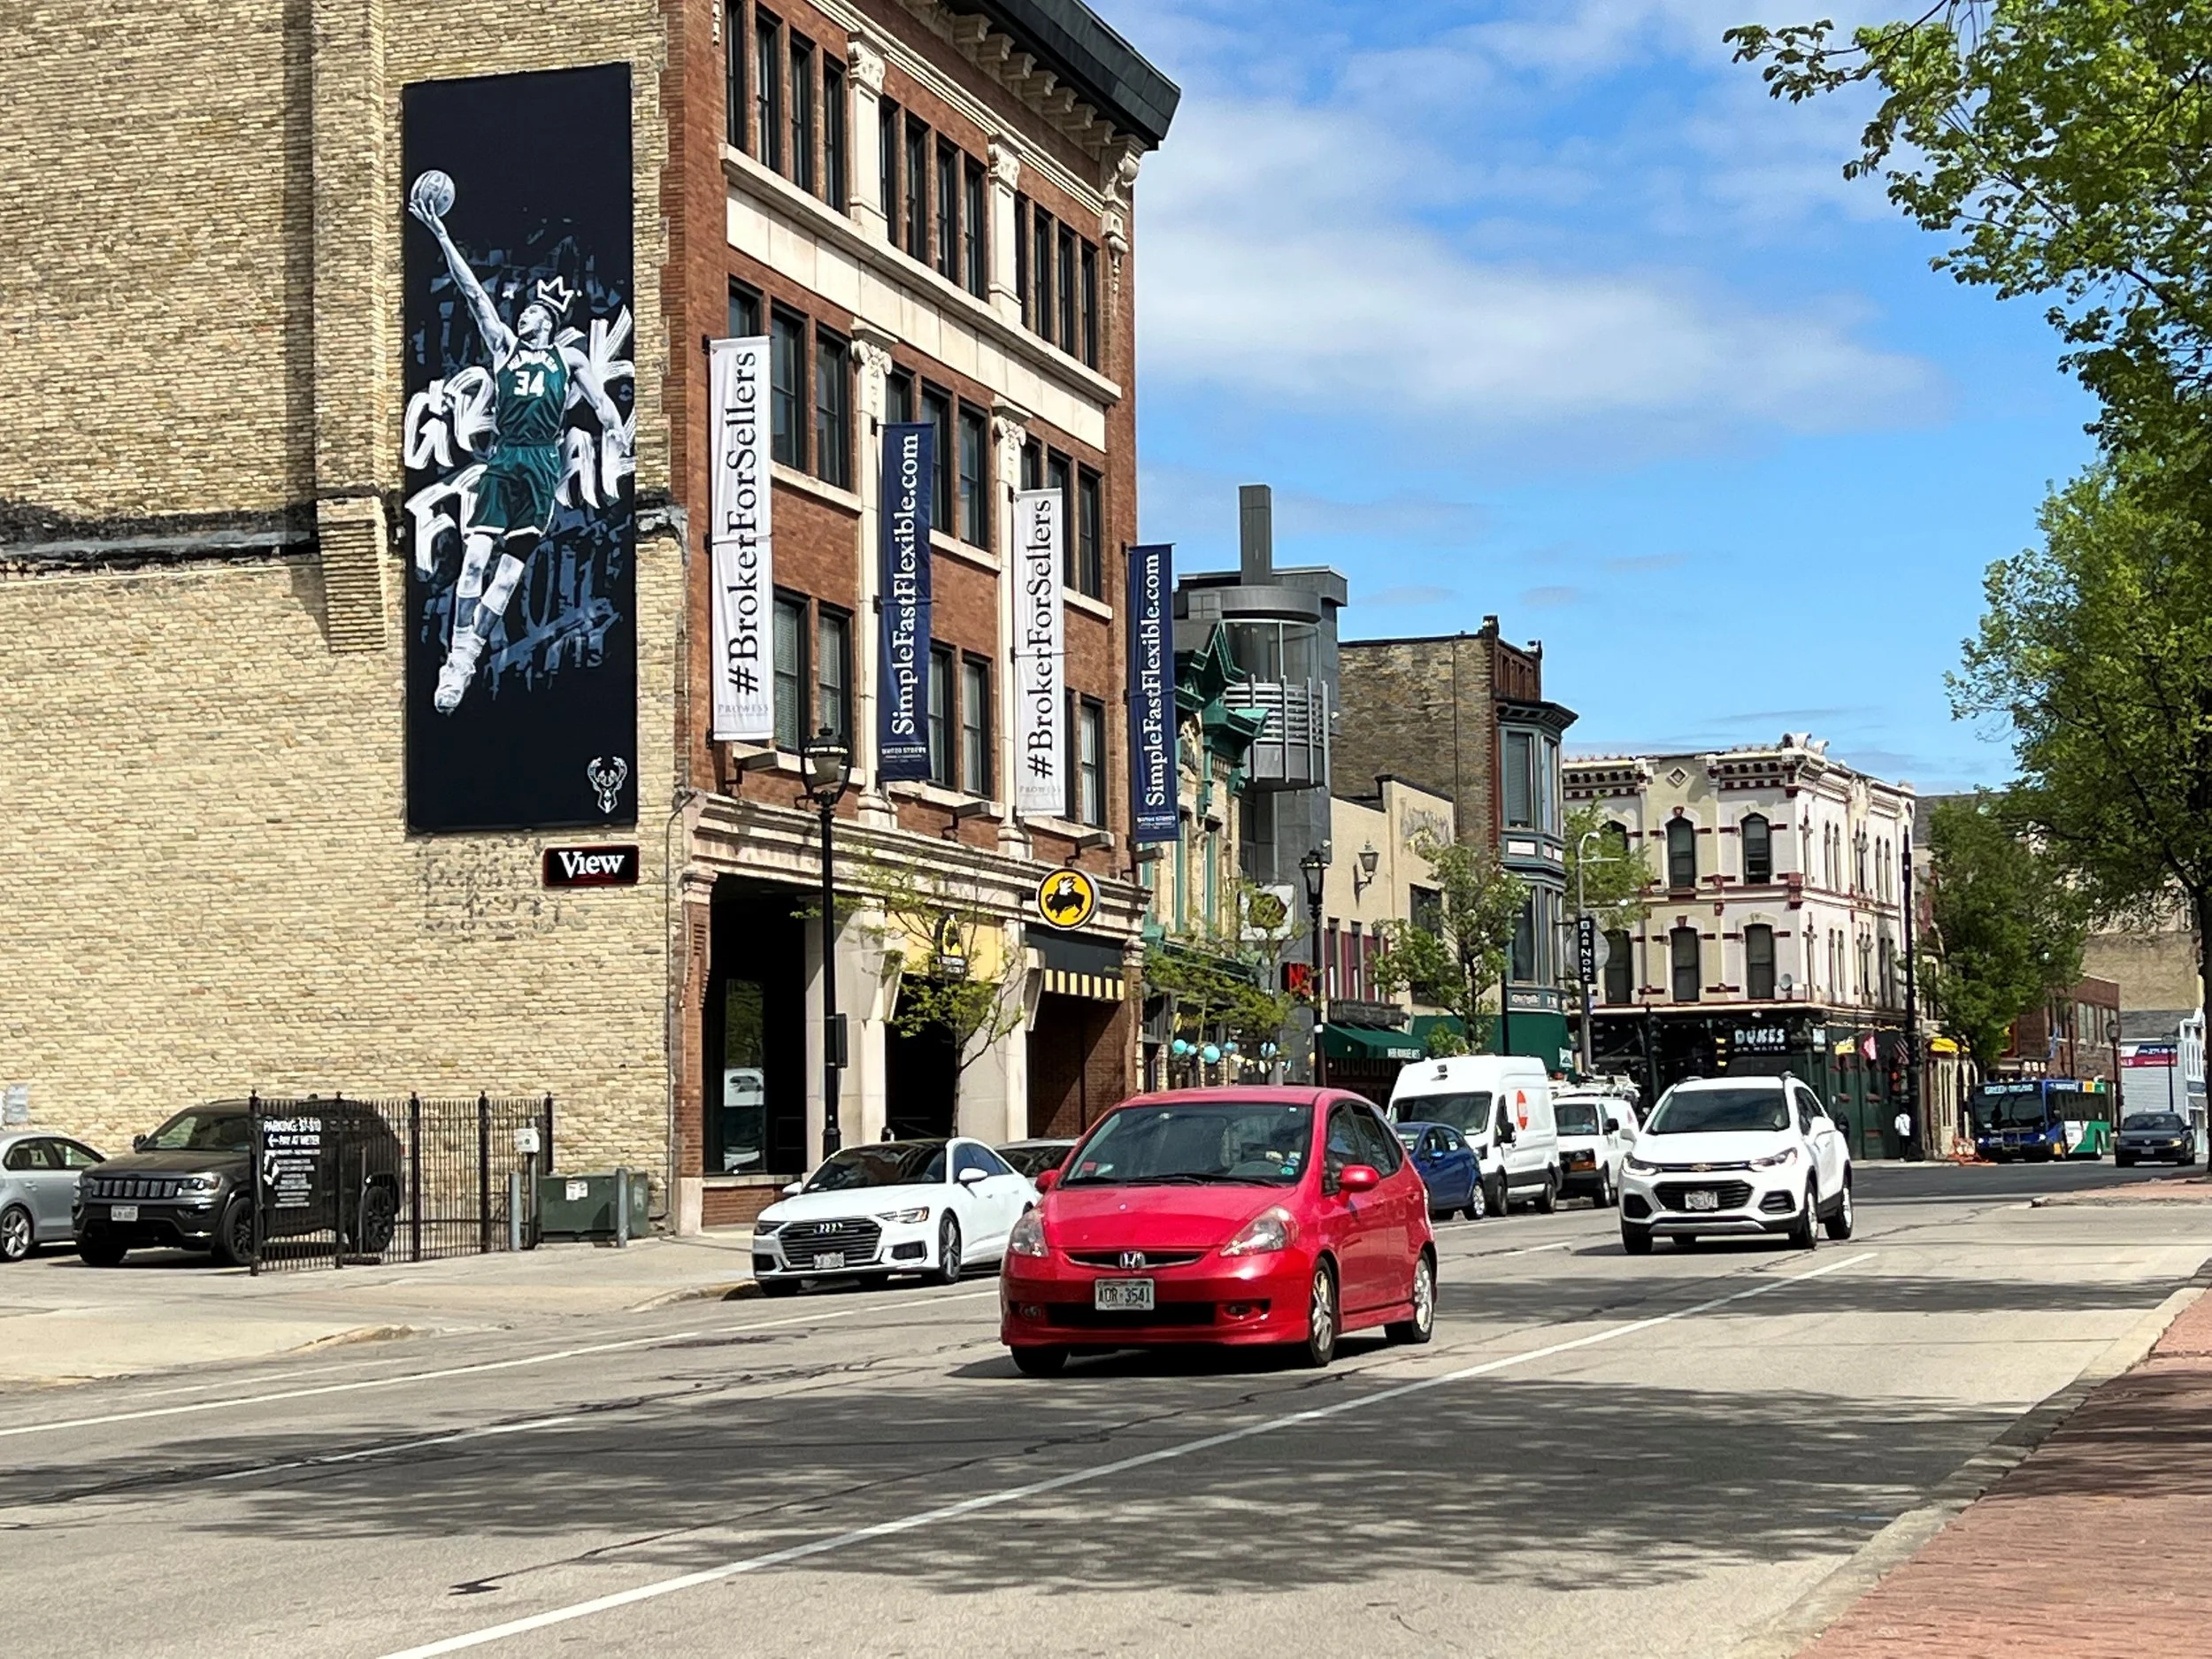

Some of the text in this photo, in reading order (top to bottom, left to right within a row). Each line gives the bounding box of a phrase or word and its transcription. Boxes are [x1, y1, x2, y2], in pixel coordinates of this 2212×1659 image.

[514, 371, 545, 396] 34
[726, 351, 759, 695] #BrokerForSellers
[892, 433, 918, 735] SimpleFastFlexible.com
[1025, 499, 1053, 780] #BrokerForSellers
[1141, 553, 1168, 806] SimpleFastFlexible.com
[558, 851, 625, 879] View
[1734, 1028, 1786, 1044] DUKES
